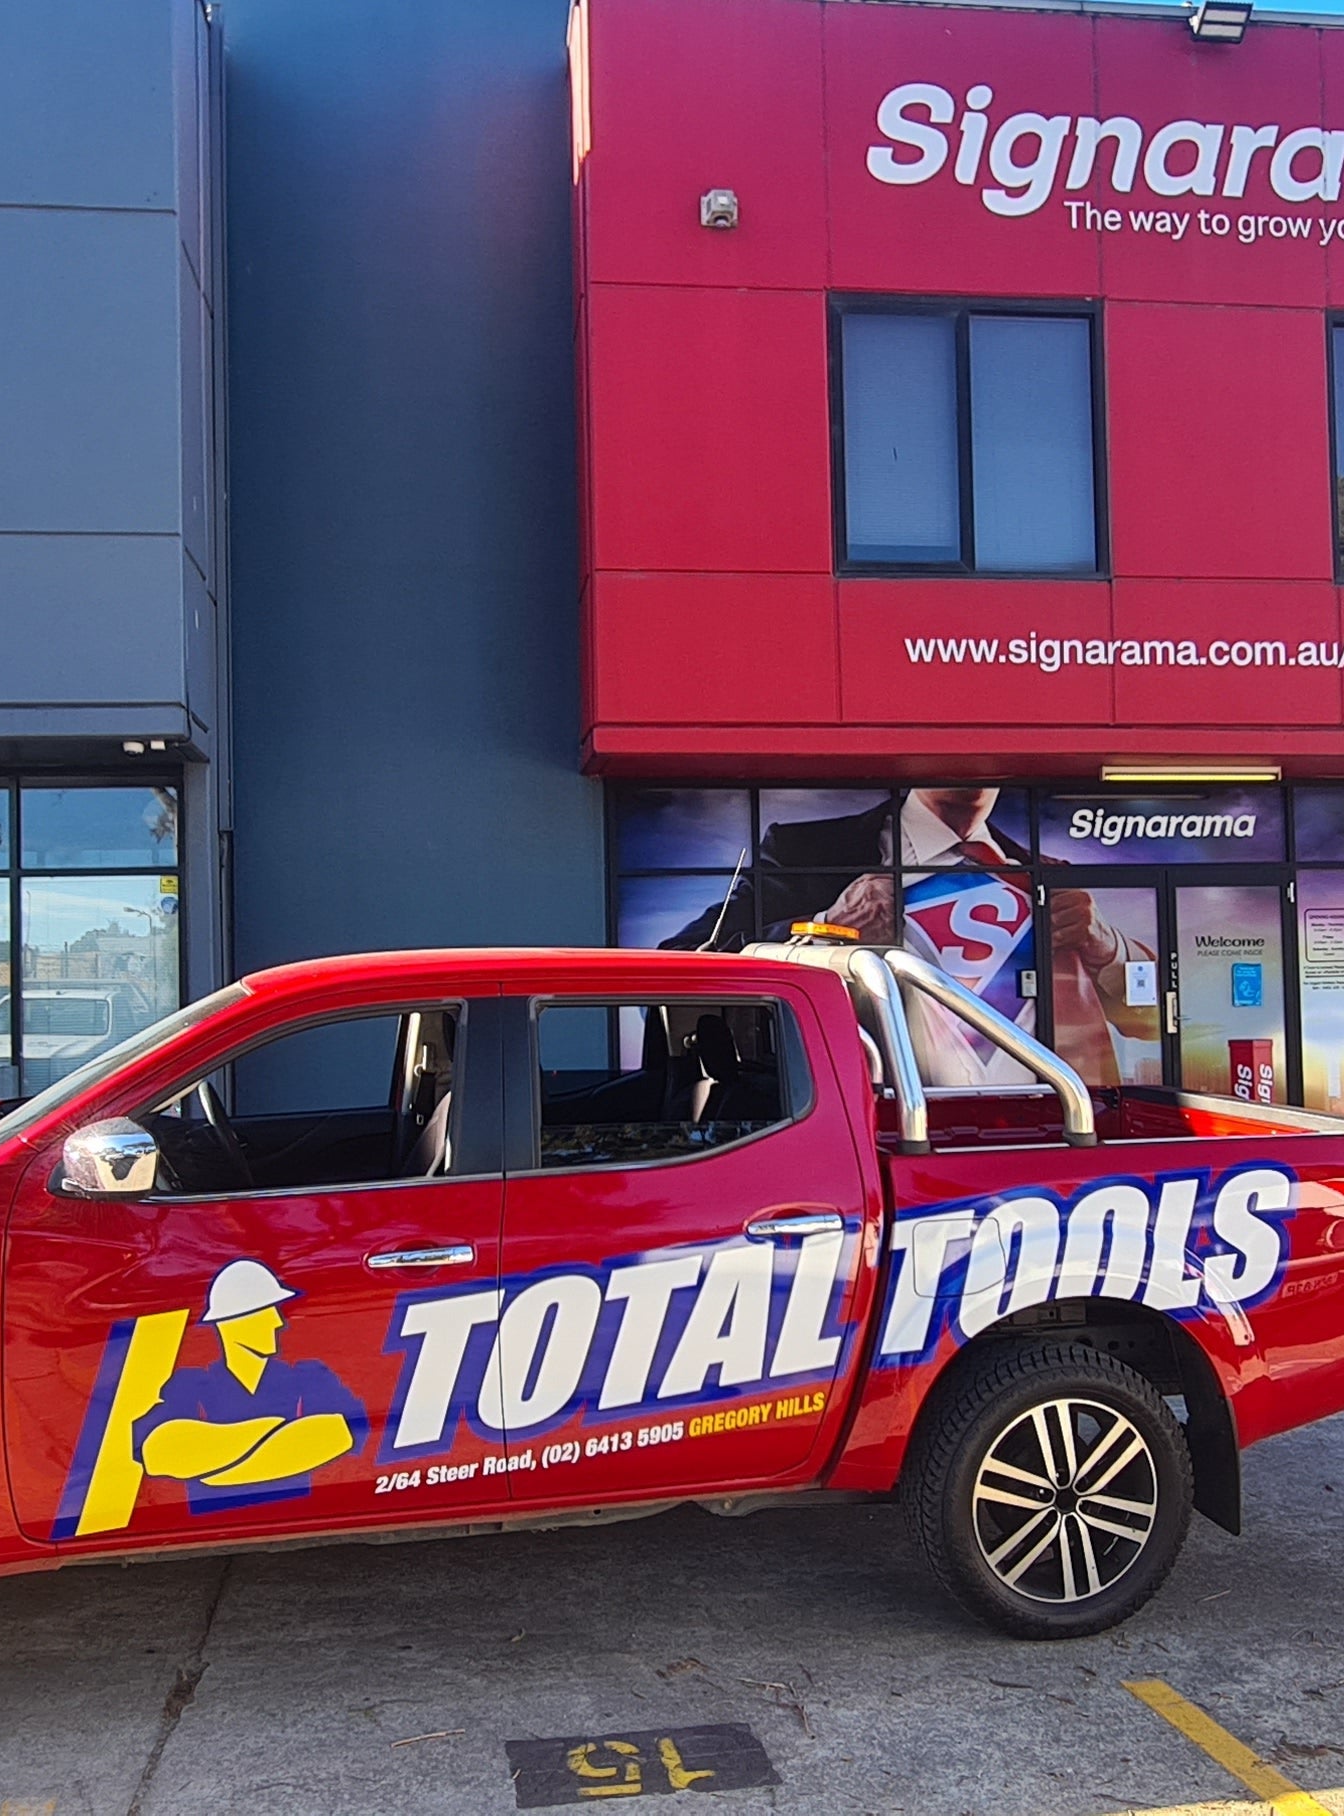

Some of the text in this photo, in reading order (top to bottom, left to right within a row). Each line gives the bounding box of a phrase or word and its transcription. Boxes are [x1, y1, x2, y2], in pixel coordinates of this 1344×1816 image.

[1063, 201, 1122, 231] The
[1128, 210, 1190, 241] way
[1197, 209, 1230, 235] to
[1237, 215, 1313, 243] grow
[1069, 808, 1257, 846] Signarama
[1195, 935, 1265, 948] Welcome
[393, 1169, 1292, 1450] TOTAL TOOLS
[374, 1391, 826, 1494] 2/64 Steer Road, (02) 6413 5905 GREGORY HILLS
